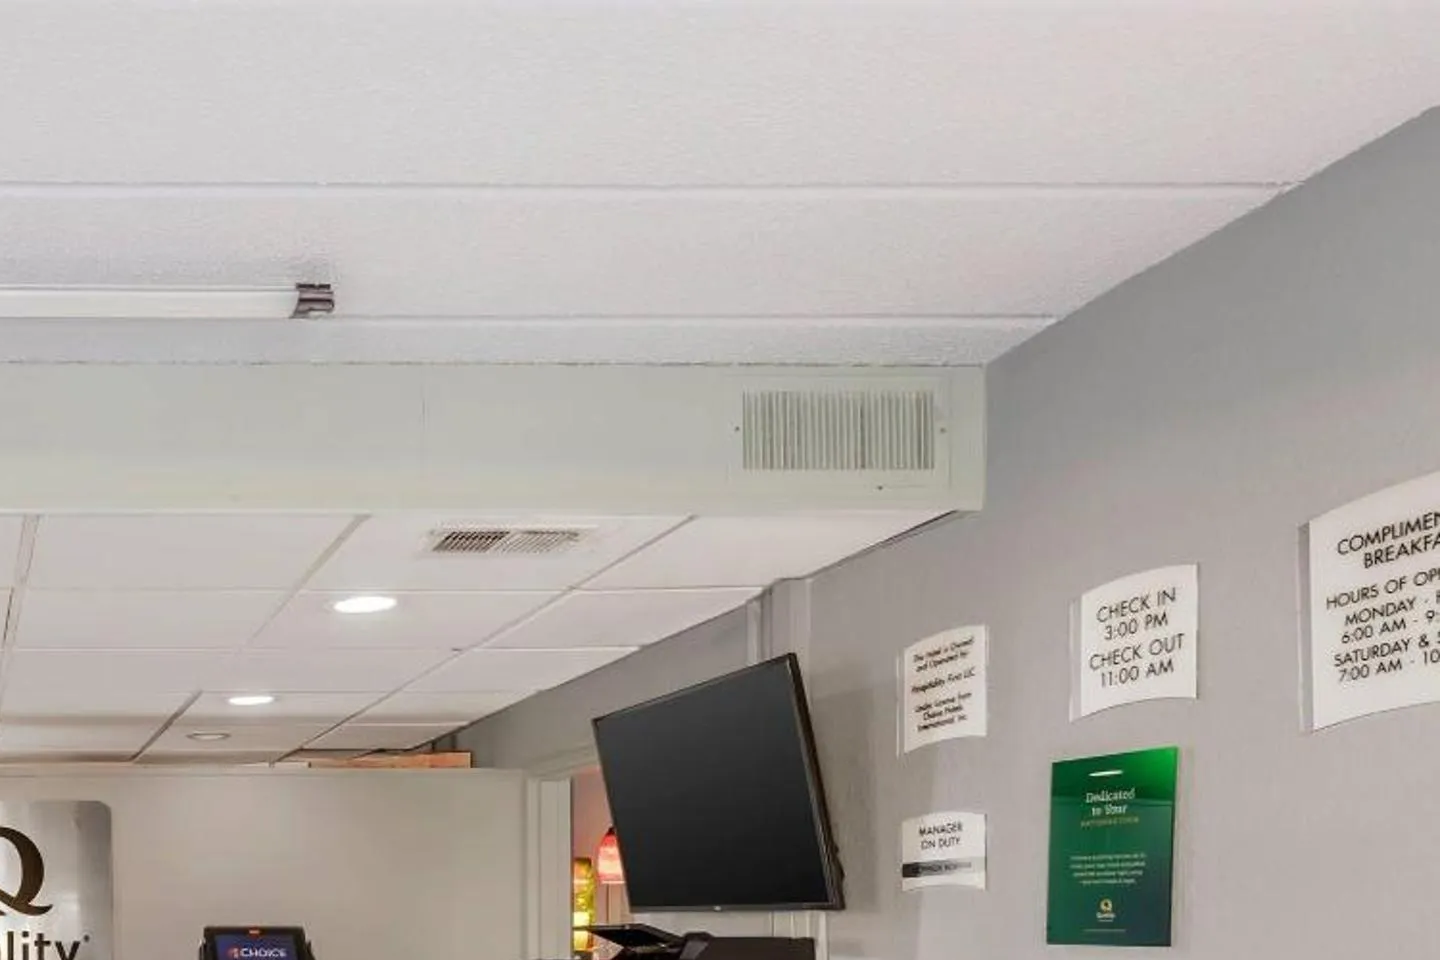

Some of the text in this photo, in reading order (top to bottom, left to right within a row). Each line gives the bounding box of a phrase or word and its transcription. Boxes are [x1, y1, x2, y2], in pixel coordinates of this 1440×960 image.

[1363, 532, 1440, 569] BREAKFA
[1096, 587, 1176, 622] CHECK IN
[1326, 583, 1379, 610] HOURS
[1383, 575, 1406, 595] OF
[1104, 611, 1169, 640] 3:00 PM
[1344, 596, 1417, 626] MONDAY
[1341, 625, 1374, 644] 6:00
[1379, 618, 1407, 636] AM
[1089, 632, 1185, 671] CHECK OUT
[1333, 637, 1412, 667] SATURDAY
[1418, 633, 1429, 648] &
[1101, 658, 1175, 688] 11:00 AM
[1338, 664, 1370, 683] 7:00
[1375, 657, 1402, 675] AM
[1086, 787, 1136, 804] Dedicated
[919, 822, 962, 836] MANAGER
[920, 836, 961, 850] ON DUTY
[240, 947, 287, 957] CHOICE
